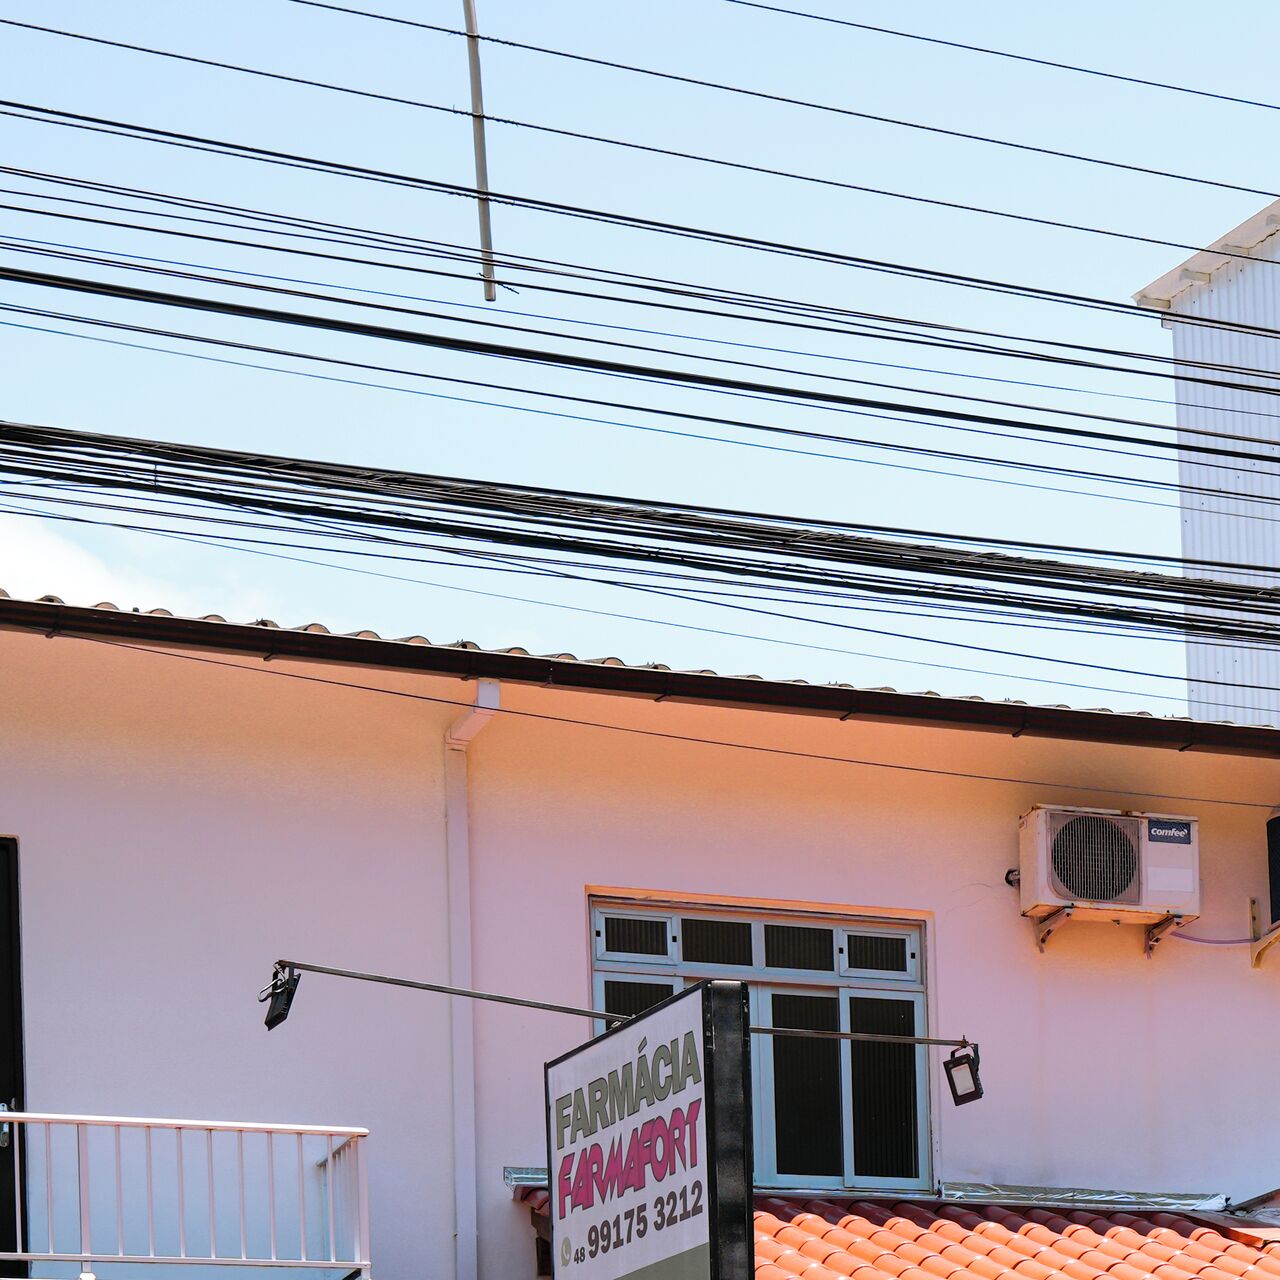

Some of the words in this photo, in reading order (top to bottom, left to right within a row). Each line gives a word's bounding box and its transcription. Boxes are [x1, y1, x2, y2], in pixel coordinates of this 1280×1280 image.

[1150, 827, 1188, 838] comfee
[556, 1036, 702, 1151] FARMÁCIA
[558, 1097, 703, 1220] FARMAFORT
[573, 1246, 586, 1265] 48
[587, 1202, 648, 1259] 99175
[653, 1179, 704, 1232] 3212
